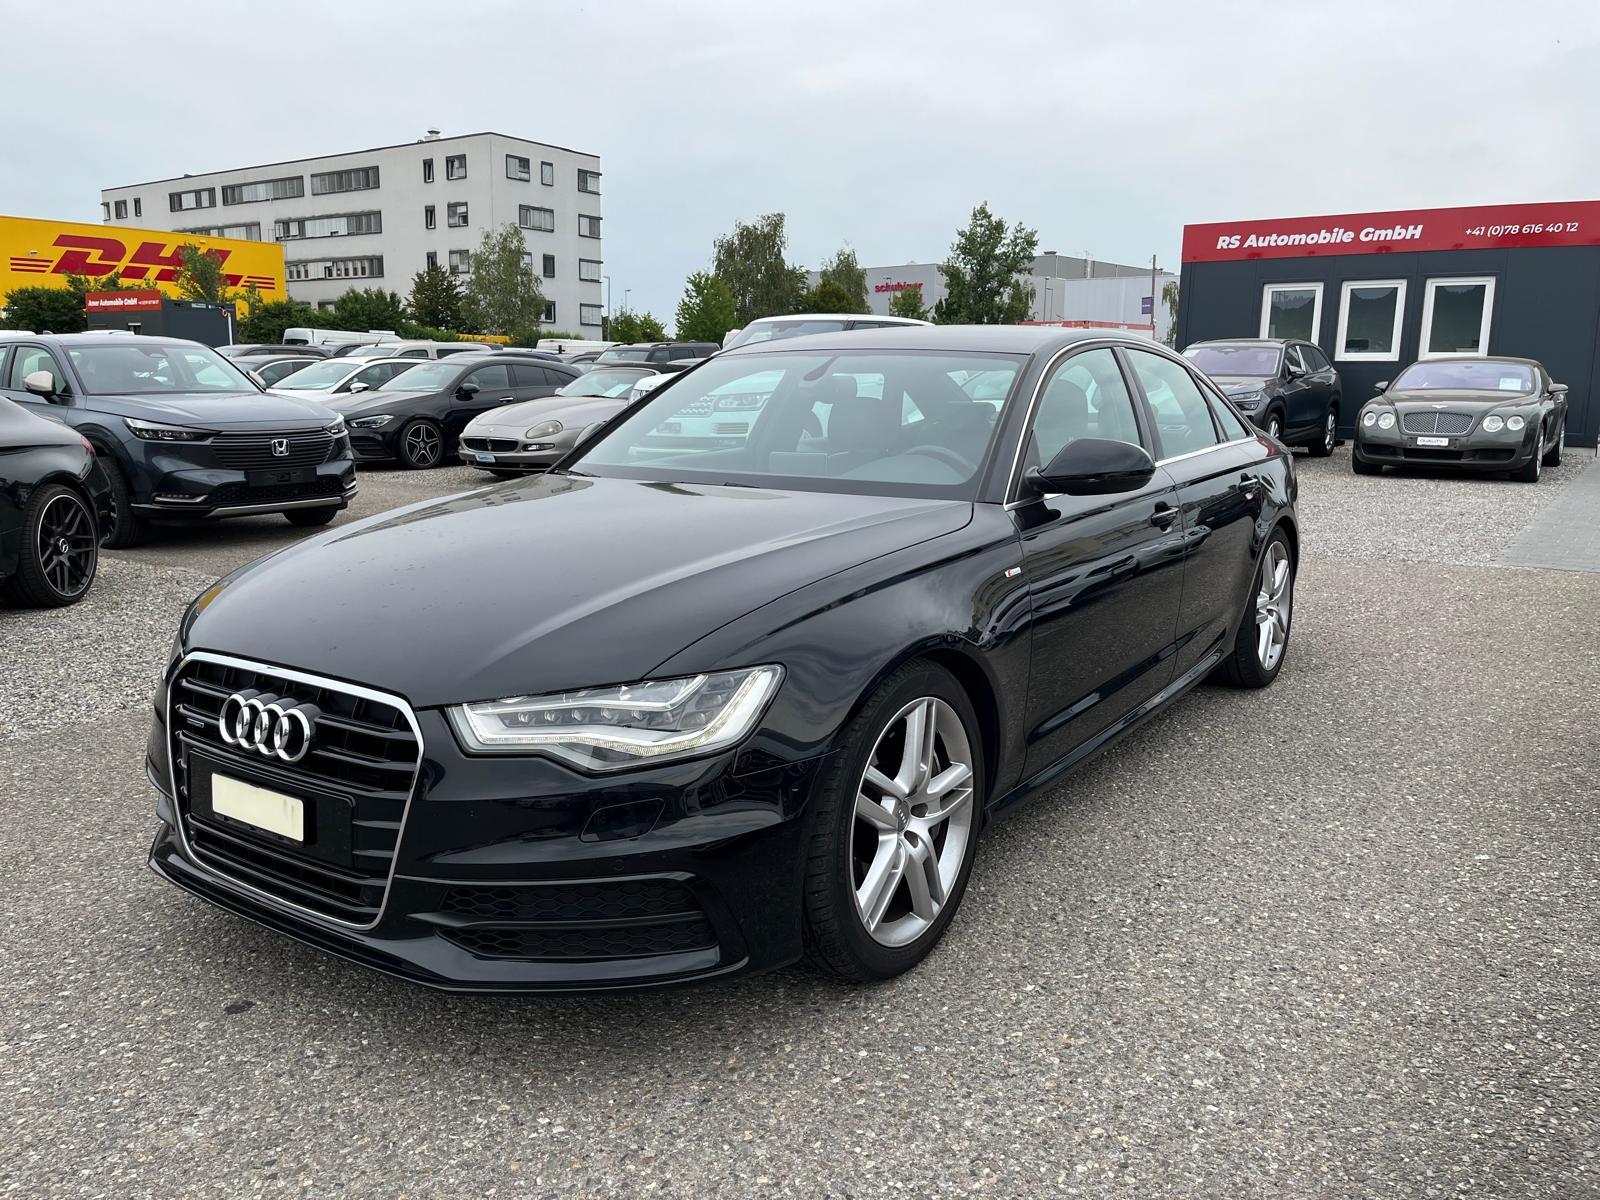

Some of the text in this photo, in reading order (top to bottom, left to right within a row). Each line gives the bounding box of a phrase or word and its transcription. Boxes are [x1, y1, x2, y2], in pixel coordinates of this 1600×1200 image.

[1216, 225, 1423, 249] RS Automobile GmbH
[1465, 222, 1579, 237] +41 (0)78 616 40 12
[51, 234, 243, 286] DHL
